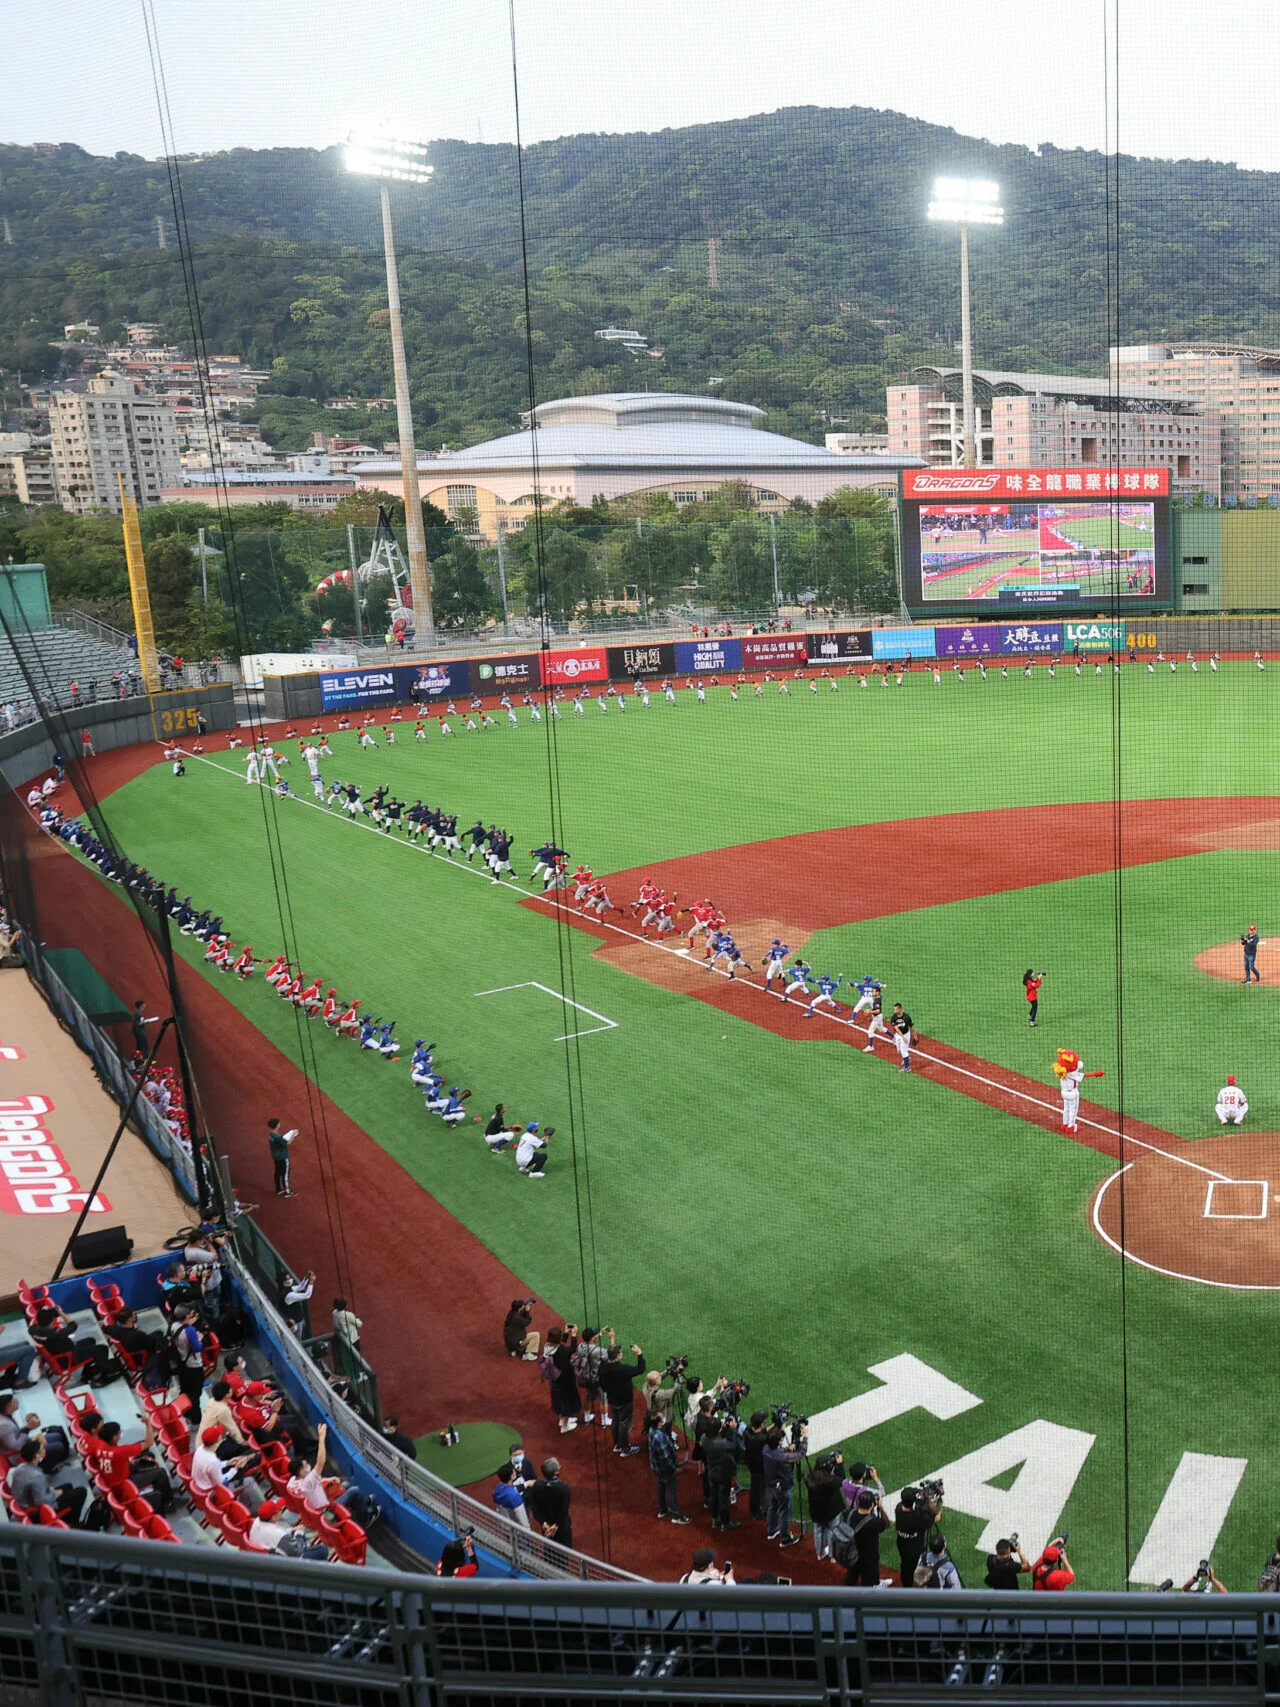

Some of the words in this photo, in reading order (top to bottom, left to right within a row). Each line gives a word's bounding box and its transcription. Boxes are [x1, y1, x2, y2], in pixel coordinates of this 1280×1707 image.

[912, 474, 1001, 492] DRAGONS
[1005, 473, 1160, 492] 味全龍職業棒球隊
[1125, 633, 1157, 648] 400
[623, 647, 662, 668] 貝納頌
[694, 659, 725, 670] QUALITY
[494, 663, 529, 677] 德克士
[322, 673, 394, 692] ELEVEN
[161, 707, 199, 732] 325
[1224, 1095, 1235, 1105] 28
